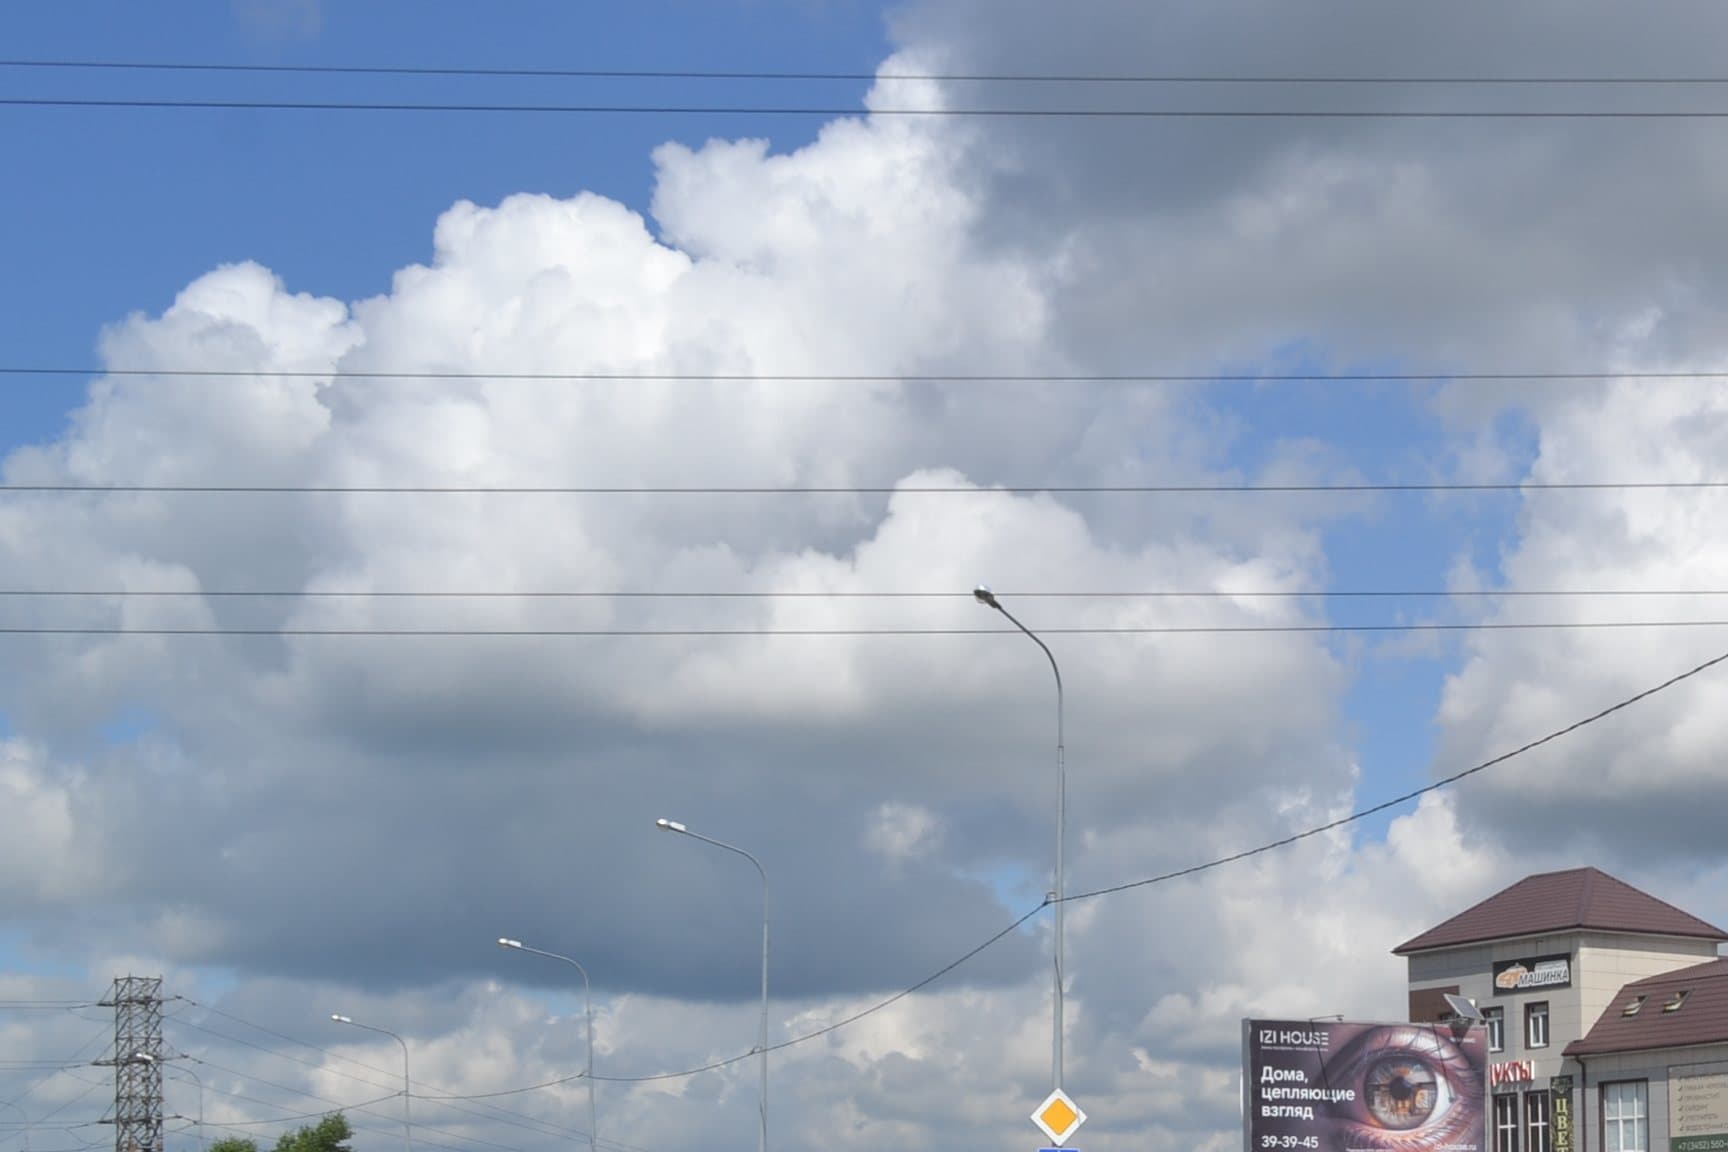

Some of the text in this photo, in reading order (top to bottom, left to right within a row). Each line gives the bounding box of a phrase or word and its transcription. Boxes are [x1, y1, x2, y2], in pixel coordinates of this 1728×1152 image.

[1519, 967, 1569, 986] МАШИНКА
[1259, 1029, 1329, 1046] IZI HOUSE
[1260, 1066, 1309, 1084] Дома,
[1261, 1087, 1355, 1104] цепляющие
[1261, 1105, 1313, 1121] взгляд
[1261, 1135, 1319, 1149] 39-39-45
